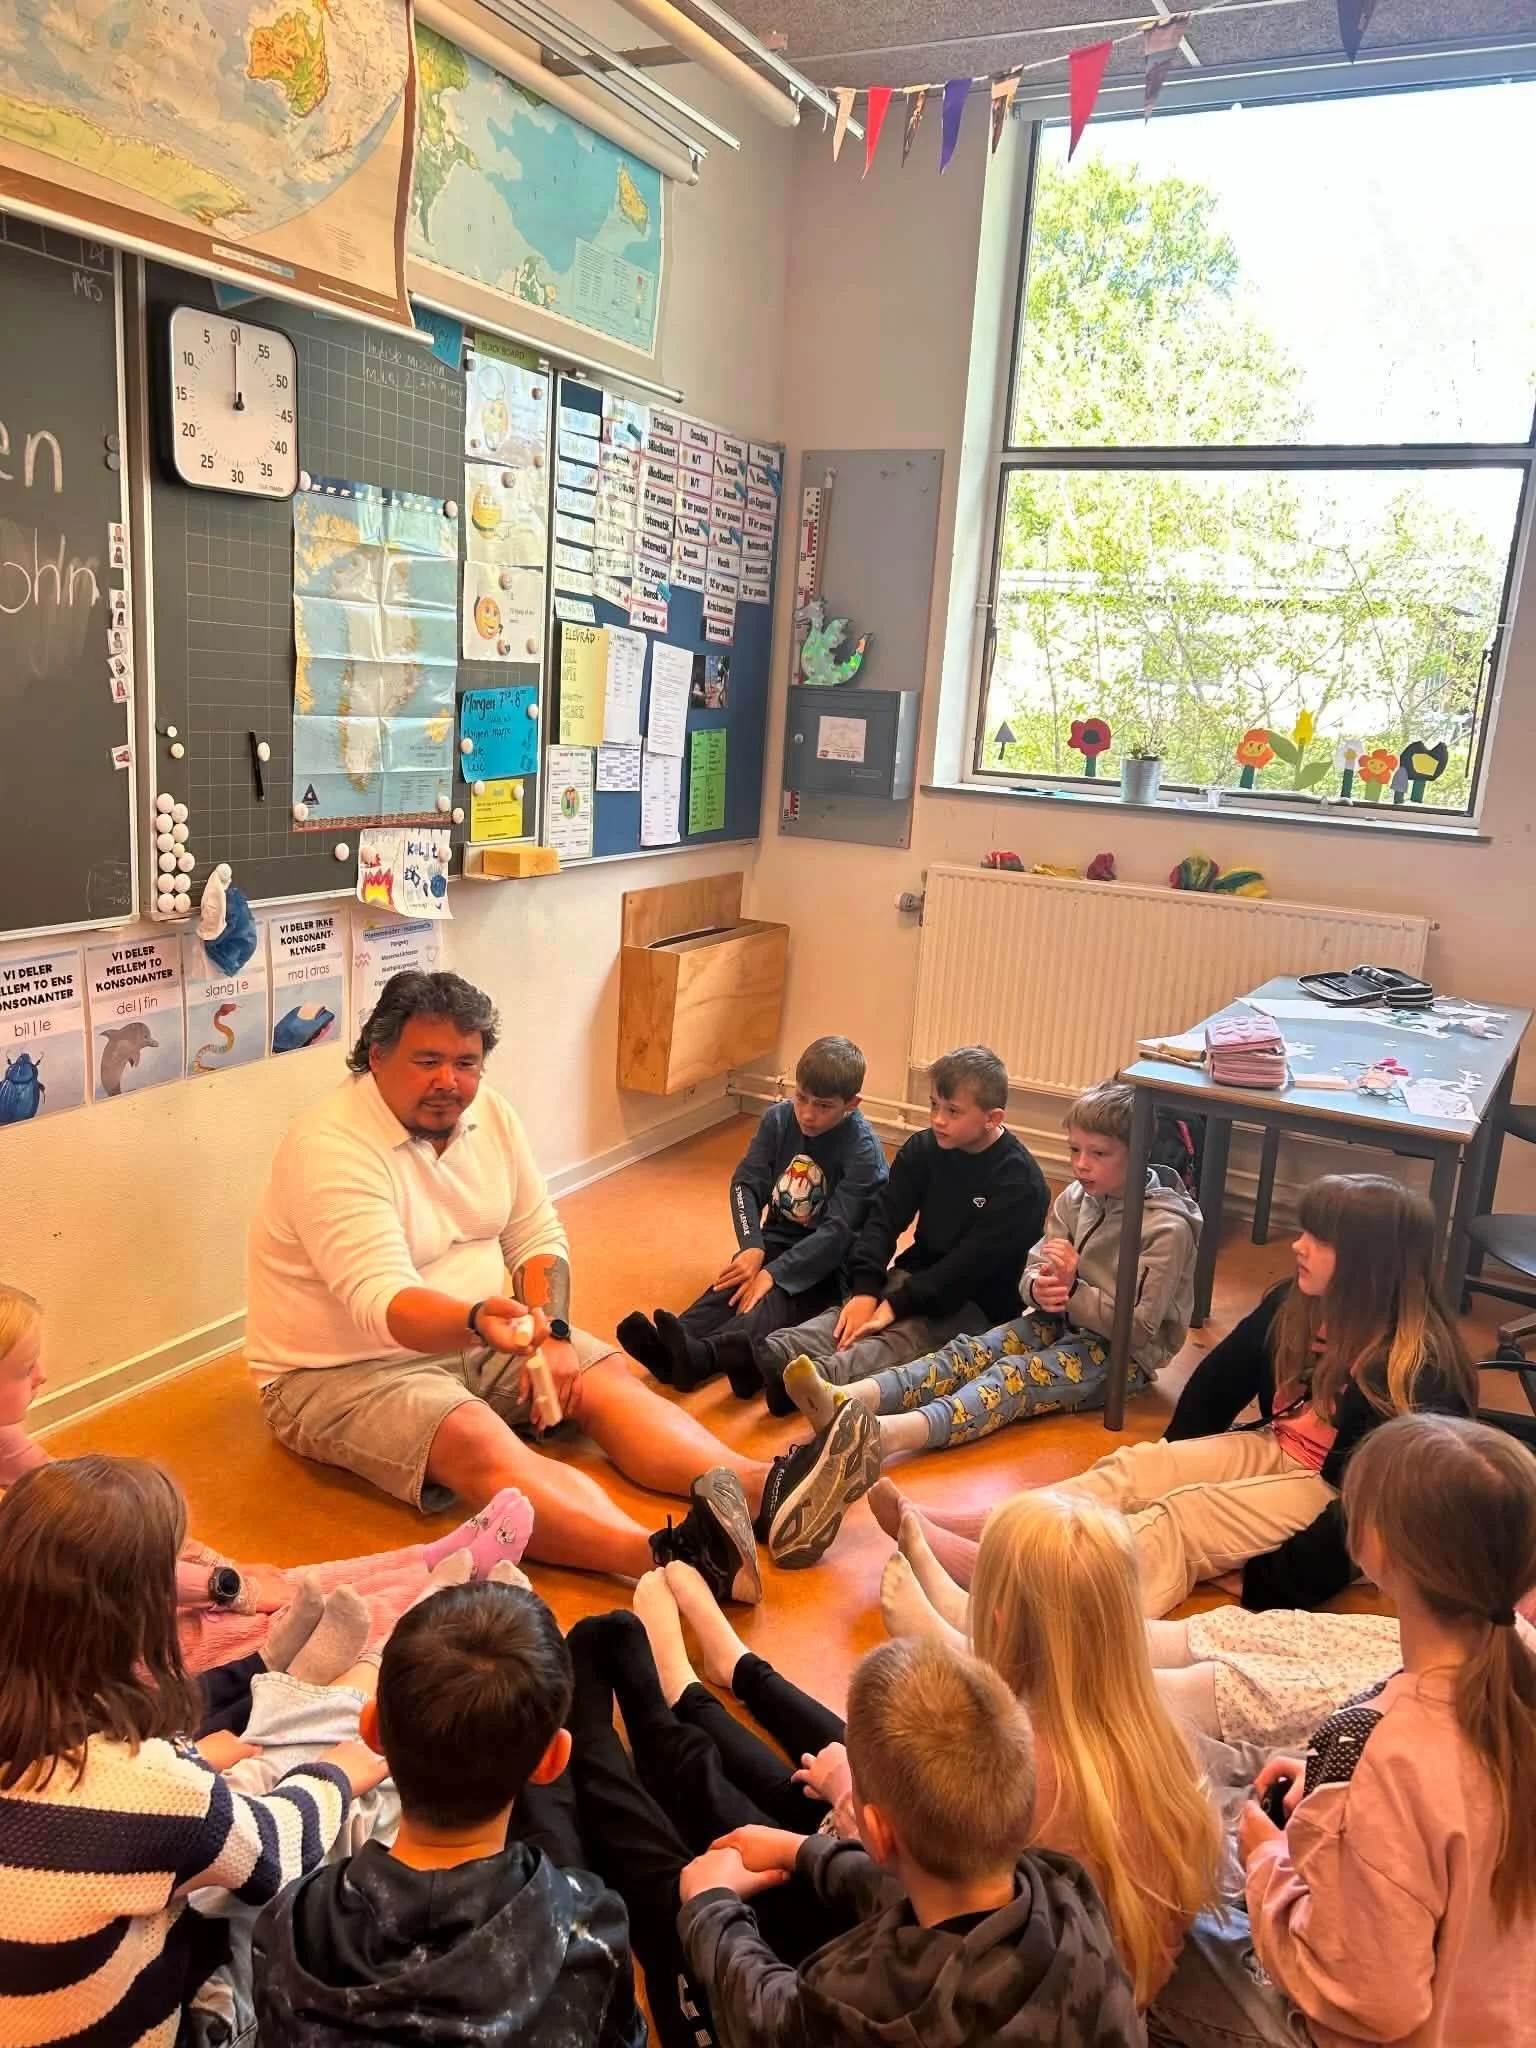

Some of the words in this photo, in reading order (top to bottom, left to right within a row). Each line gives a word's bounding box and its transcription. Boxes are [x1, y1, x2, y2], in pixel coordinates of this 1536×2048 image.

[203, 329, 211, 344] 5
[183, 351, 194, 366] 10
[258, 344, 270, 359] 55
[276, 375, 288, 389] 50
[176, 386, 187, 401] 15
[281, 410, 293, 424] 45
[182, 423, 196, 437] 20
[275, 440, 288, 454] 40
[201, 454, 214, 469] 25
[231, 469, 244, 483] 30
[260, 463, 273, 477] 35
[280, 923, 290, 934] VI
[291, 920, 314, 932] DELER
[315, 917, 335, 929] IKKE
[112, 951, 123, 963] VI
[125, 945, 156, 960] DELER
[290, 942, 327, 957] KLYNGER
[3, 969, 16, 981] VI
[18, 963, 53, 978] DELER
[106, 959, 148, 977] MELLEM
[149, 957, 162, 969] TO
[33, 977, 48, 990] TO
[51, 974, 74, 987] ENS
[95, 968, 174, 993] KONSONANTER
